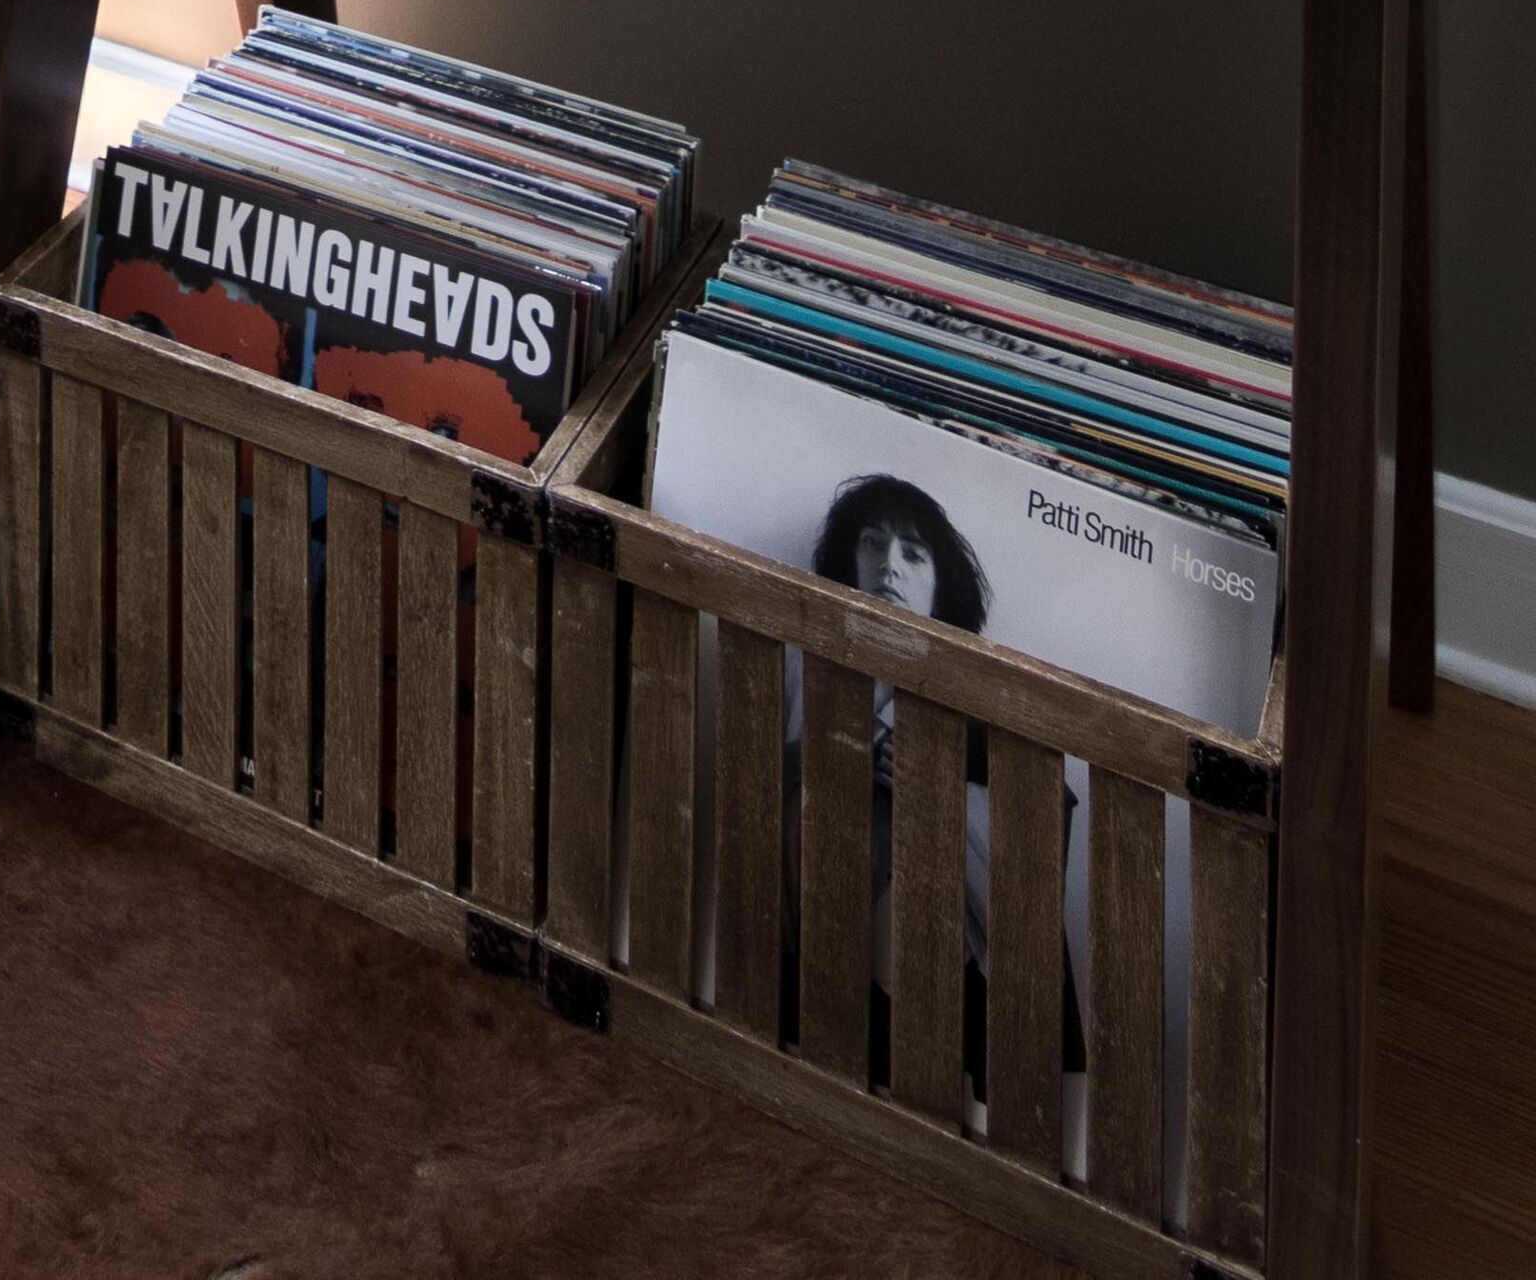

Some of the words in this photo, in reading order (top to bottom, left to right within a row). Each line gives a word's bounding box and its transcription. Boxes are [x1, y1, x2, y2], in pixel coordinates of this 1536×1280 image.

[1027, 488, 1081, 536] Patti
[1083, 511, 1154, 565] Smith
[1171, 544, 1256, 603] Horses
